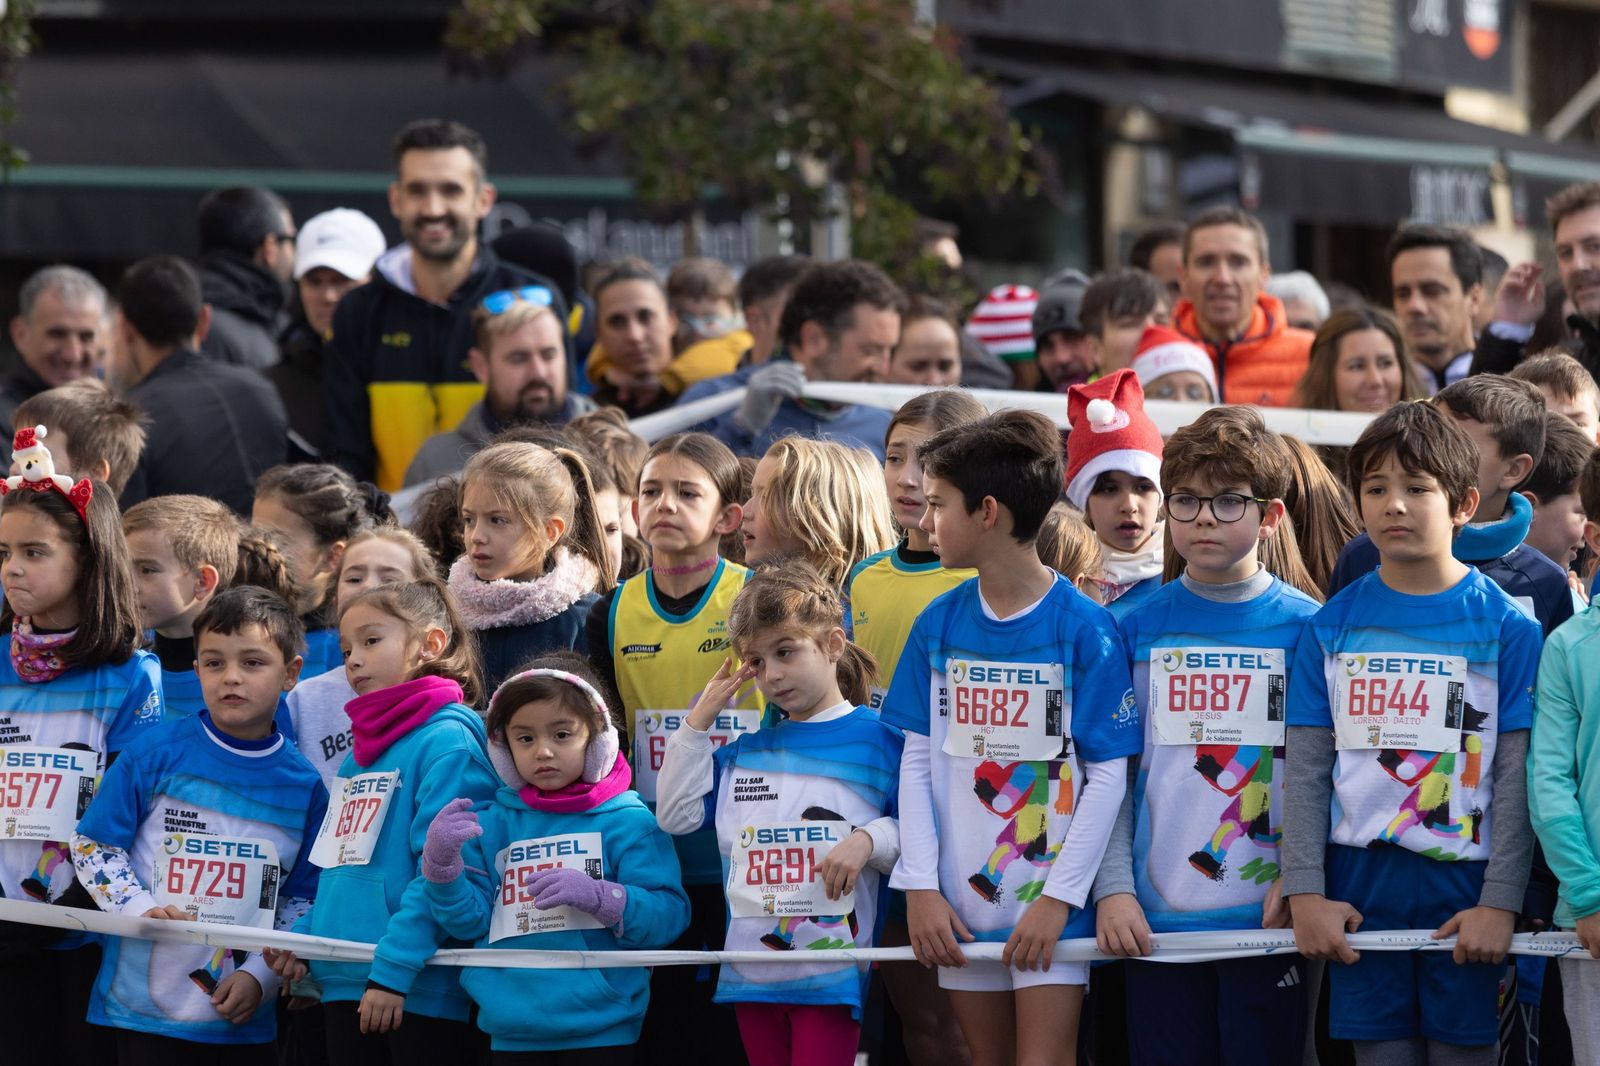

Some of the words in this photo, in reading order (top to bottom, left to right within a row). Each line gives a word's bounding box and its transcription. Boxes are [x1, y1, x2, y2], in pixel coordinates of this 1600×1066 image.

[1186, 653, 1272, 670] SETEL
[1367, 657, 1452, 676] SETEL
[969, 666, 1050, 685] SETEL
[1168, 674, 1252, 712] 6687
[1348, 678, 1430, 717] 6644
[956, 686, 1029, 727] 6682
[1194, 711, 1222, 720] JESUS
[1353, 716, 1388, 725] LORENZO
[664, 716, 747, 730] SEL
[1382, 732, 1418, 740] Ayuntamiento
[986, 742, 1020, 750] Ayuntamiento
[1389, 739, 1418, 747] Salamanca
[6, 752, 84, 771] SETEL
[734, 785, 770, 793] SILVESTRE
[734, 793, 779, 802] SALMANTINA
[165, 808, 178, 817] XLI
[180, 810, 198, 819] SAN
[335, 798, 382, 837] 6977
[17, 823, 51, 832] Ayuntamiento
[164, 817, 207, 830] SILVESTRE
[757, 826, 838, 844] SETEL
[185, 839, 267, 860] SETEL
[510, 839, 588, 863] SETEL
[746, 848, 815, 886] 6691
[167, 857, 246, 899] 6729
[760, 884, 800, 893] VICTORIA
[192, 896, 215, 906] ARES
[200, 911, 235, 921] Ayuntamiento
[531, 914, 564, 924] Ayuntamiento
[538, 922, 565, 932] Salamanca
